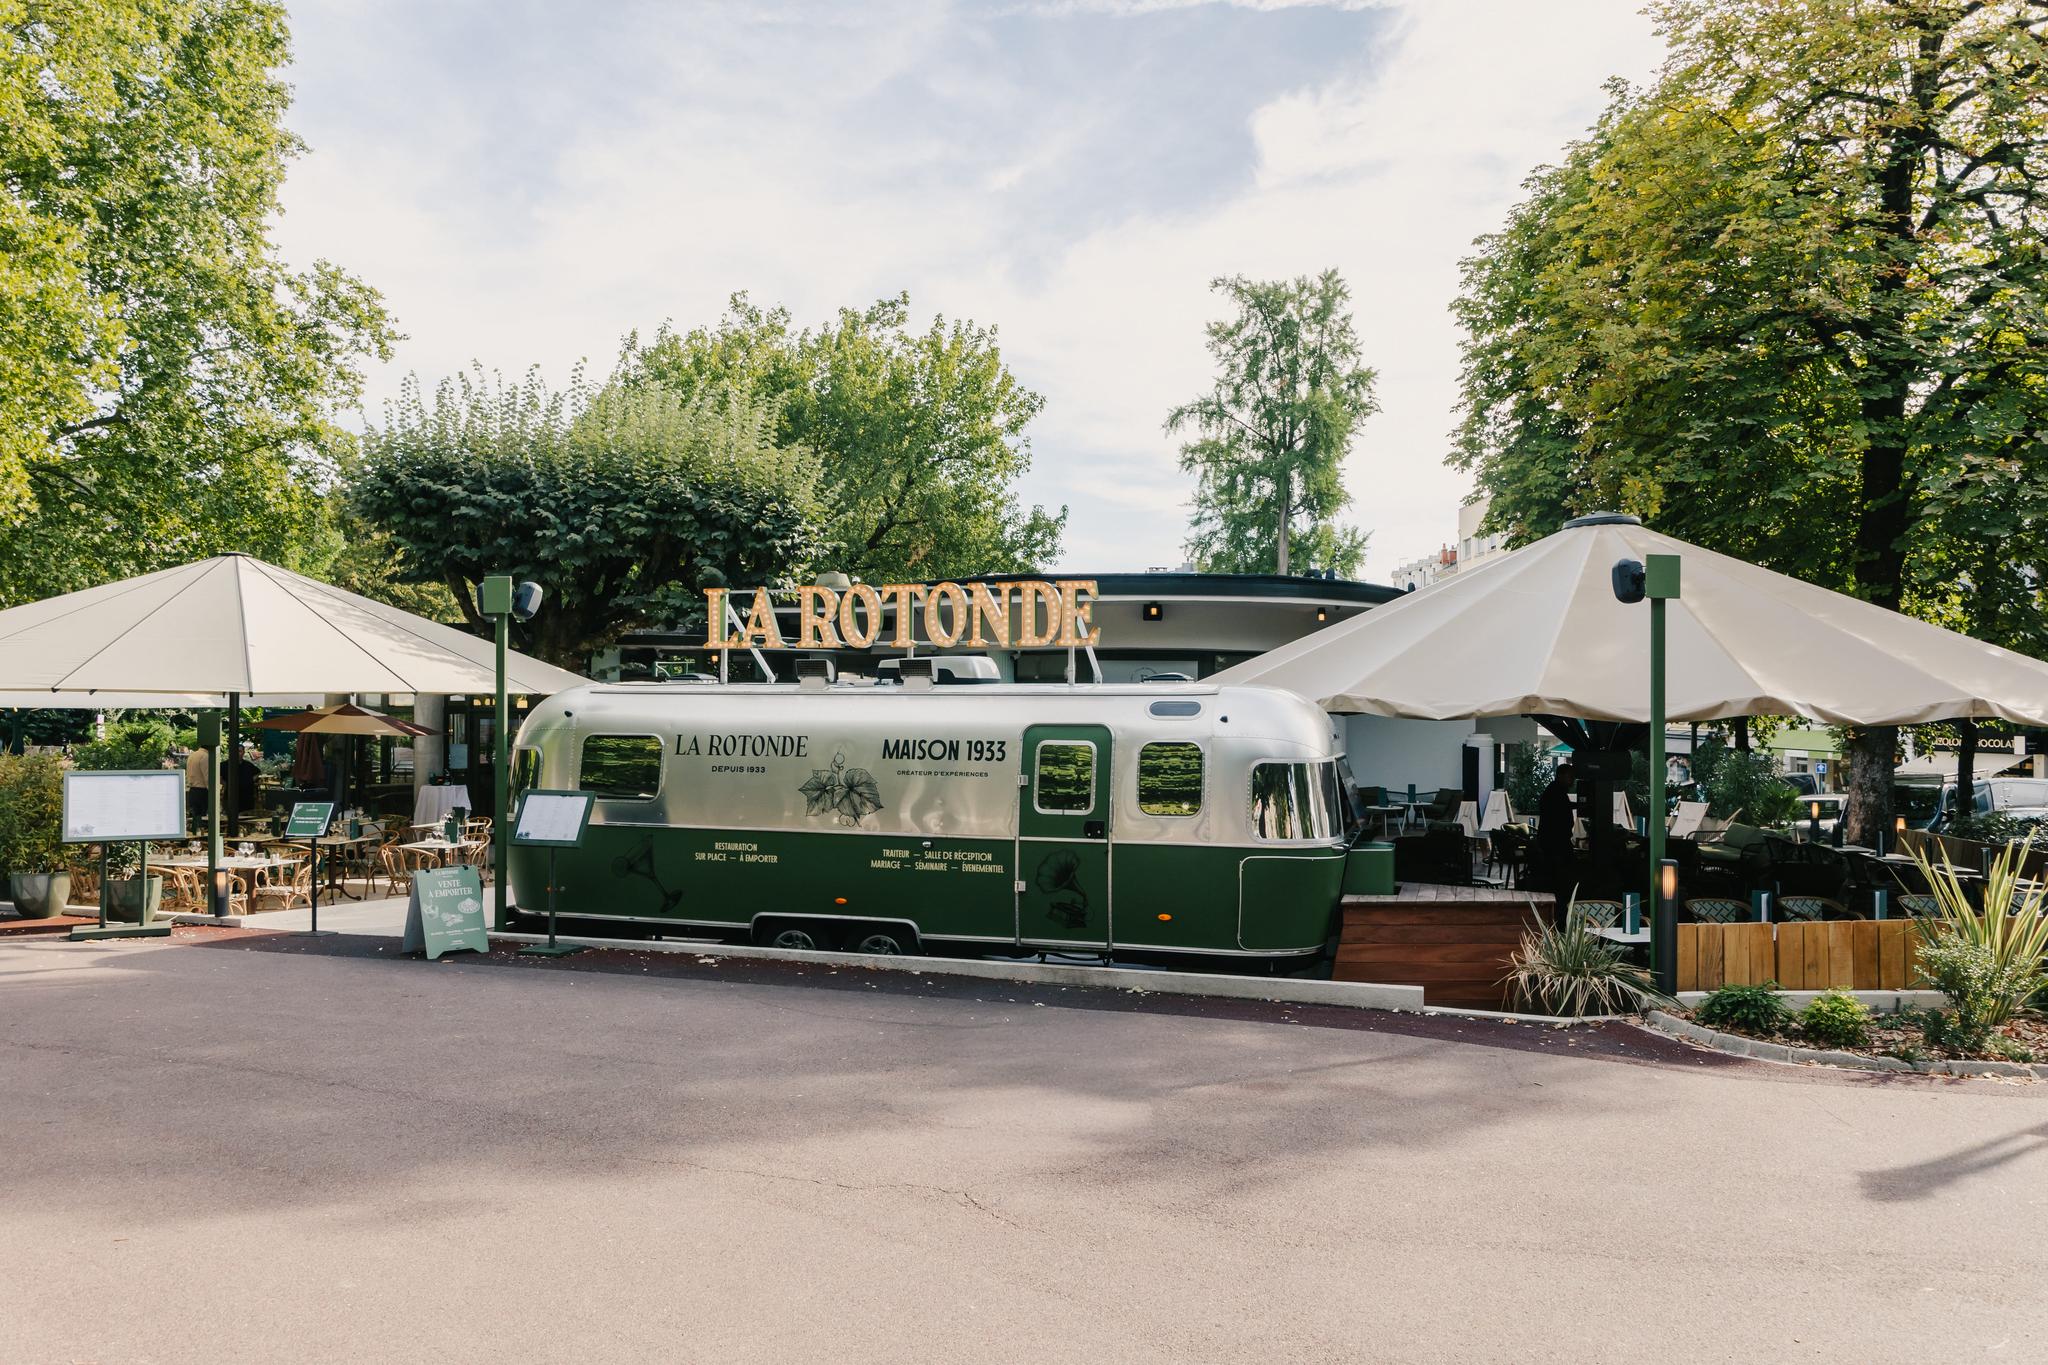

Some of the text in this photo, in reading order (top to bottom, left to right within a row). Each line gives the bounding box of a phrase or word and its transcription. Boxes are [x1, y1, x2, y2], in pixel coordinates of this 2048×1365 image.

[703, 580, 1101, 649] LA ROTONDE
[674, 734, 809, 758] LA ROTONDE
[882, 739, 1006, 762] MAISON 1933
[711, 765, 766, 774] DEPUIS 1933
[714, 842, 758, 851] RESTAURATION
[694, 852, 706, 860] SUR
[707, 853, 727, 861] PLACE
[739, 851, 744, 862] À
[745, 854, 778, 863] EMPORTER
[882, 849, 910, 858] TRAITEUR
[924, 850, 941, 860] SALLE
[942, 851, 953, 860] DE
[953, 849, 992, 861] RÉCEPTION
[870, 860, 901, 869] MARIAGE
[914, 859, 948, 871] SÉMINAIRE
[437, 879, 462, 888] VENTE
[435, 887, 473, 898] EMPORTER
